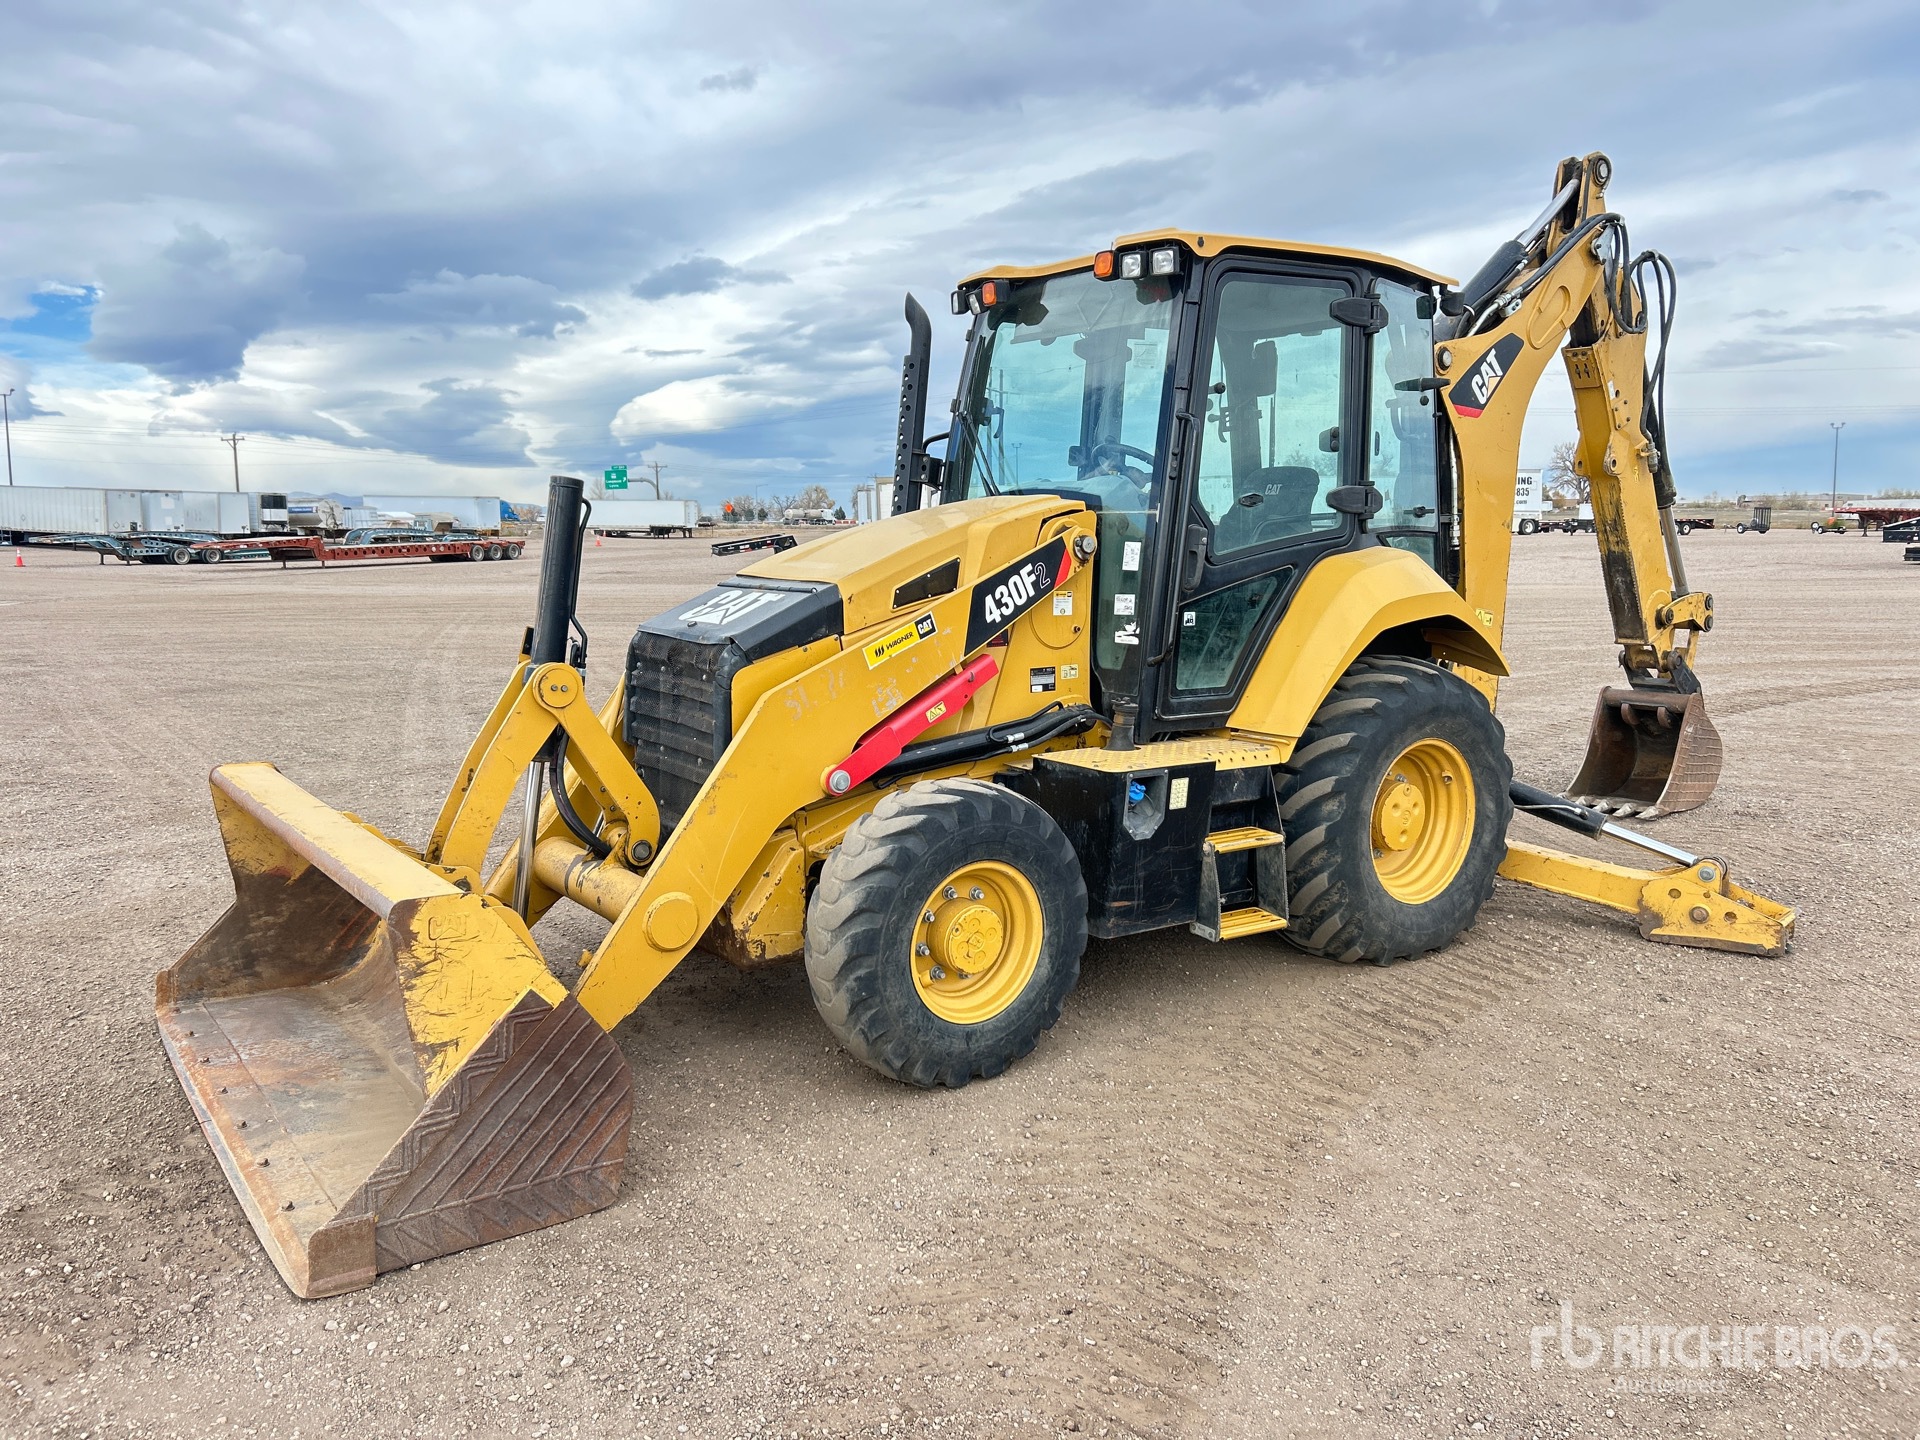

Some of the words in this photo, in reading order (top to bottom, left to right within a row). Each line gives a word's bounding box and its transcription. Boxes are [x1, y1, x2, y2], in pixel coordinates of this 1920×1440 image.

[1472, 348, 1503, 404] CAT
[1265, 484, 1282, 495] CAT
[678, 590, 785, 625] CAT
[985, 562, 1050, 623] 430F2
[886, 631, 914, 650] WAGNER
[917, 619, 932, 634] CAT
